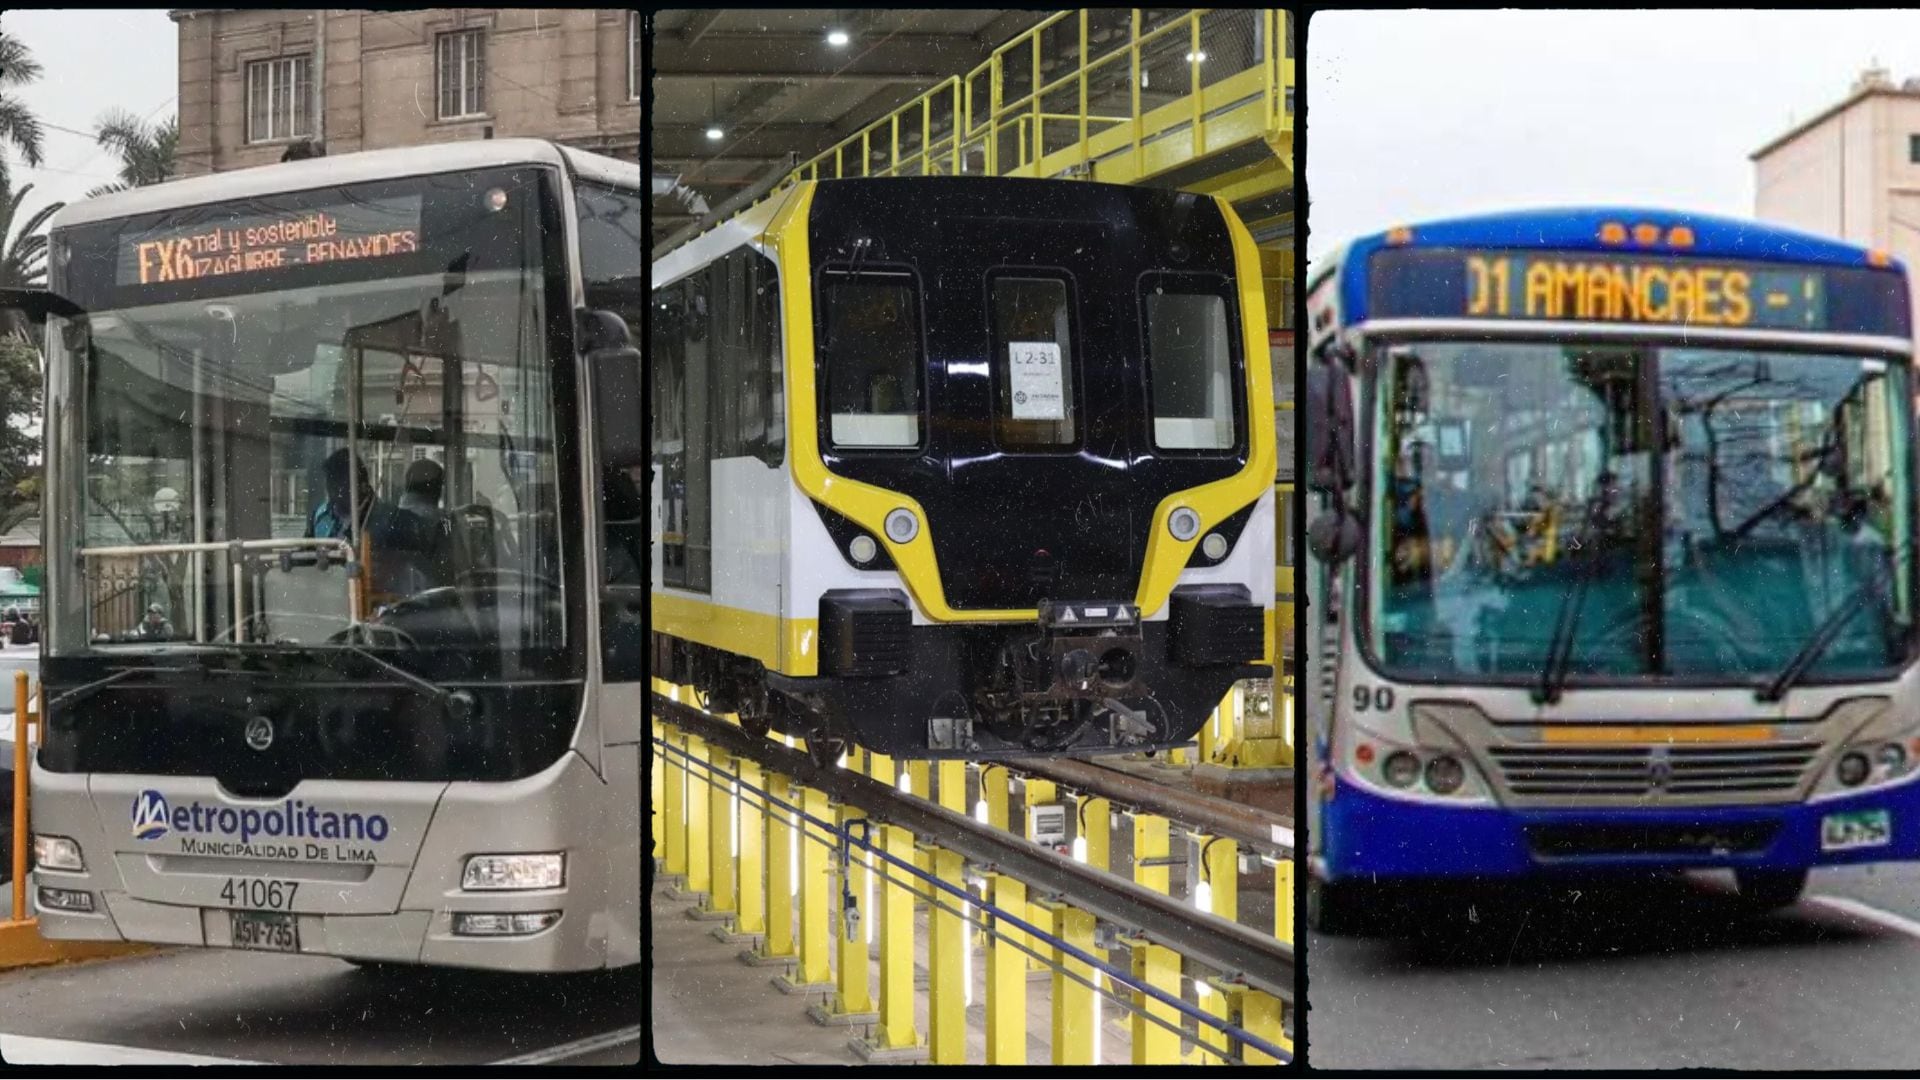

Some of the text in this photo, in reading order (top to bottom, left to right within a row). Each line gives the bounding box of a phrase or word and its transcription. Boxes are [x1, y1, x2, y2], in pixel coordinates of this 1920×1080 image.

[229, 230, 240, 253] y
[246, 213, 336, 247] sostenible
[1527, 259, 1750, 324] AMANCAES
[1353, 685, 1394, 711] 90
[133, 789, 389, 841] Metropolitano
[220, 878, 300, 910] 41067
